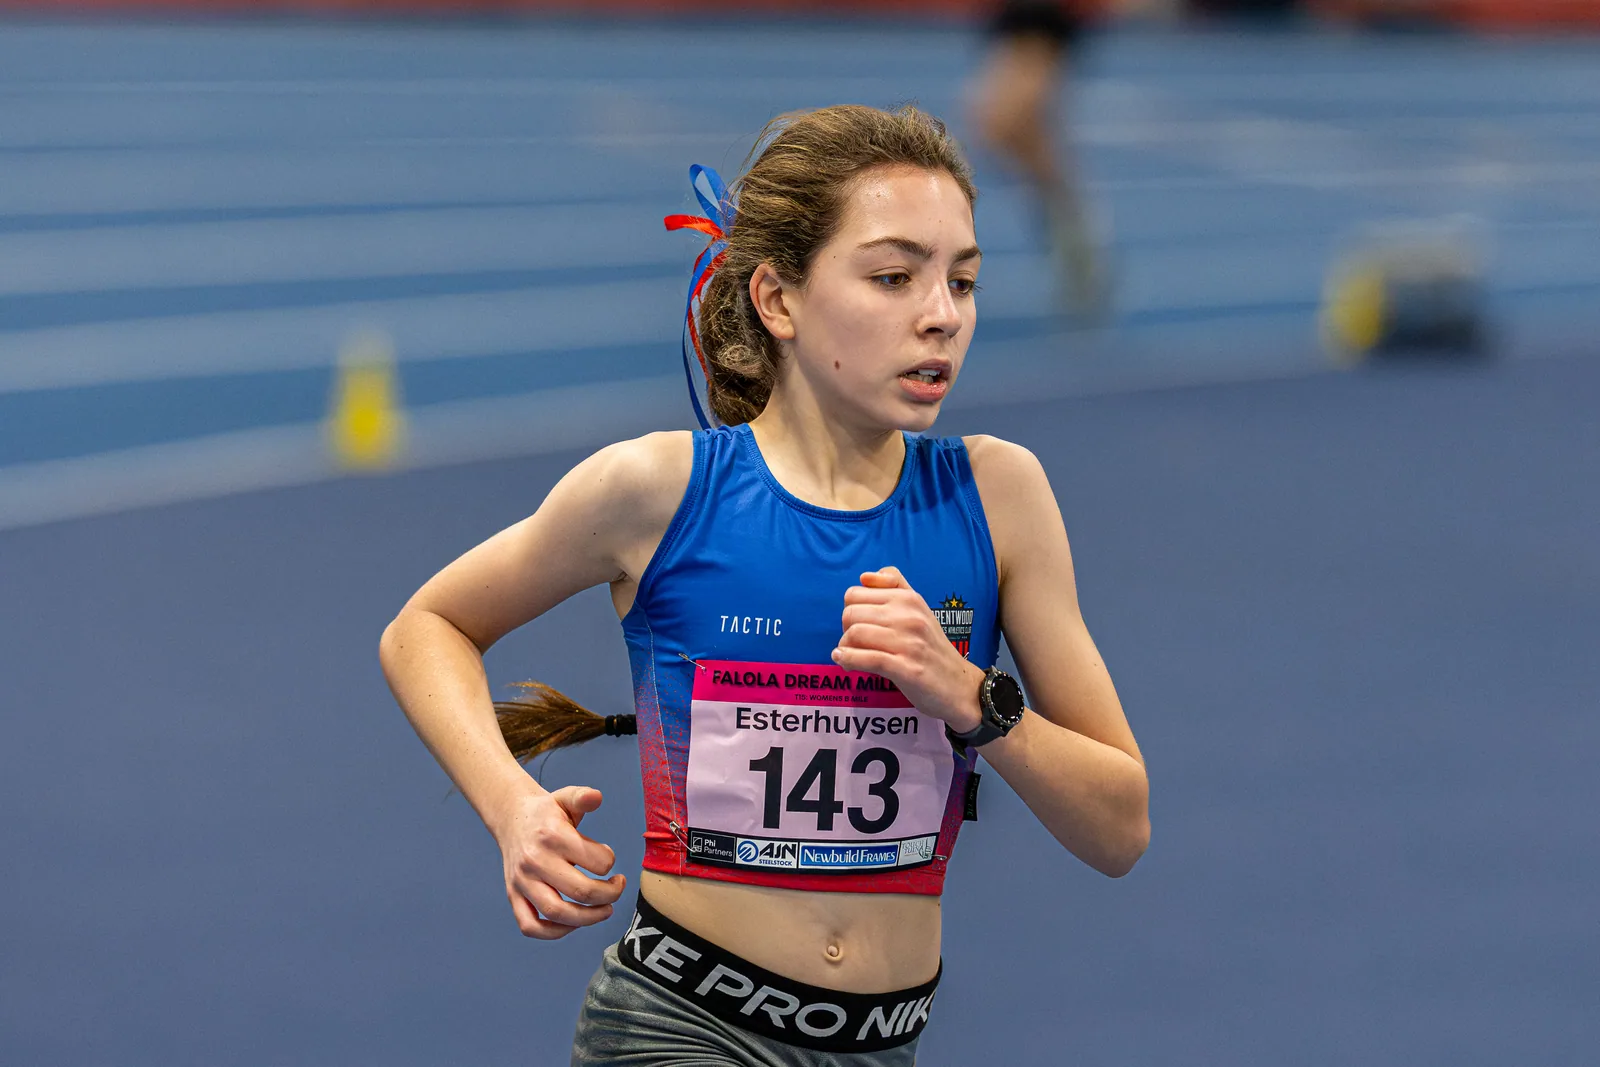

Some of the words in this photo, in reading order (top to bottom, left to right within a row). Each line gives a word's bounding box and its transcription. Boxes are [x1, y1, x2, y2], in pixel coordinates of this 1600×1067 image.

[720, 615, 782, 636] TACTIC
[931, 610, 974, 625] RENTWOOD
[713, 670, 779, 688] FALOLA
[784, 673, 852, 691] DREAM
[810, 694, 843, 702] WOMENS
[735, 707, 919, 739] Esterhuysen
[749, 746, 900, 834] 143
[704, 838, 716, 847] Phi
[759, 842, 797, 859] AJN
[703, 846, 733, 857] Partners
[759, 858, 793, 866] STEELSTOCK
[694, 963, 847, 1038] PRO
